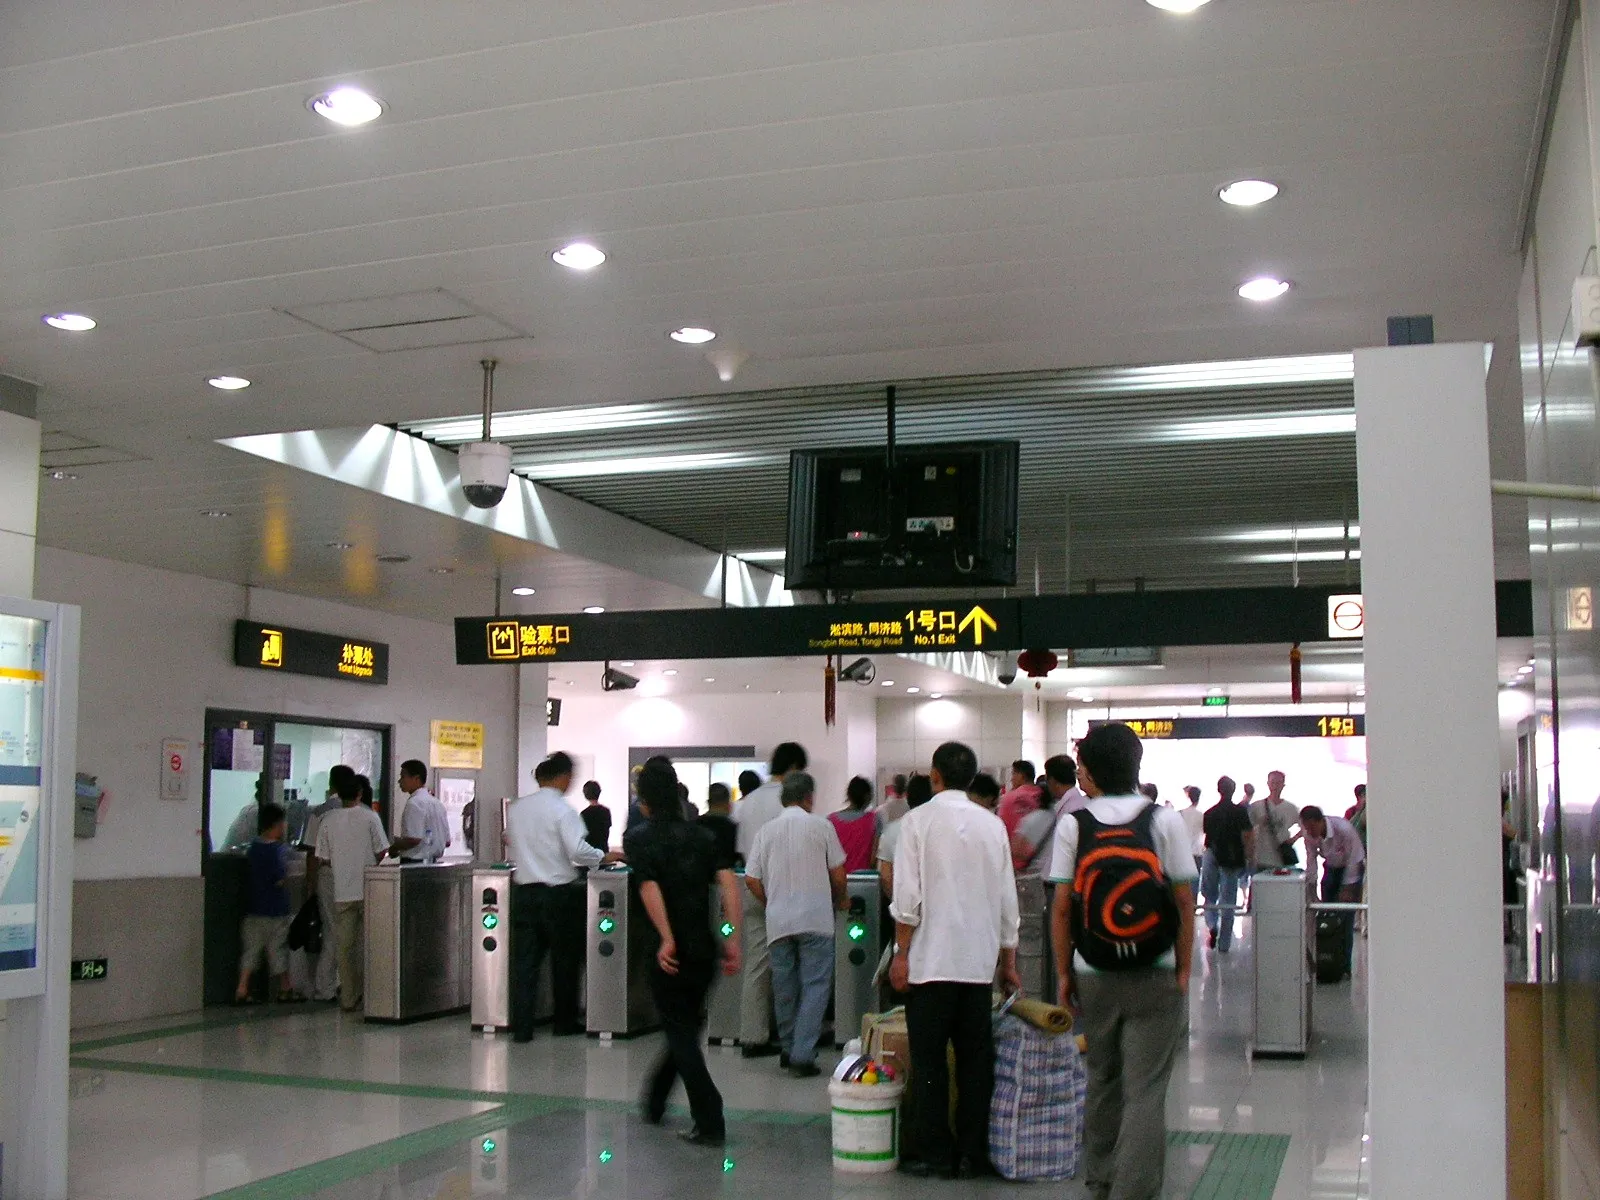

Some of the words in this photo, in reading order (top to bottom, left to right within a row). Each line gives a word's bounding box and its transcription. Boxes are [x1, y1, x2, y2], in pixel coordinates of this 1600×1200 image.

[905, 610, 956, 631] 1号口
[520, 625, 569, 645] 验票口
[883, 637, 903, 645] Road
[914, 634, 935, 645] No.1
[938, 633, 956, 645] Exit
[342, 643, 374, 666] 补票处
[521, 646, 537, 656] Exit
[537, 646, 556, 655] Gate
